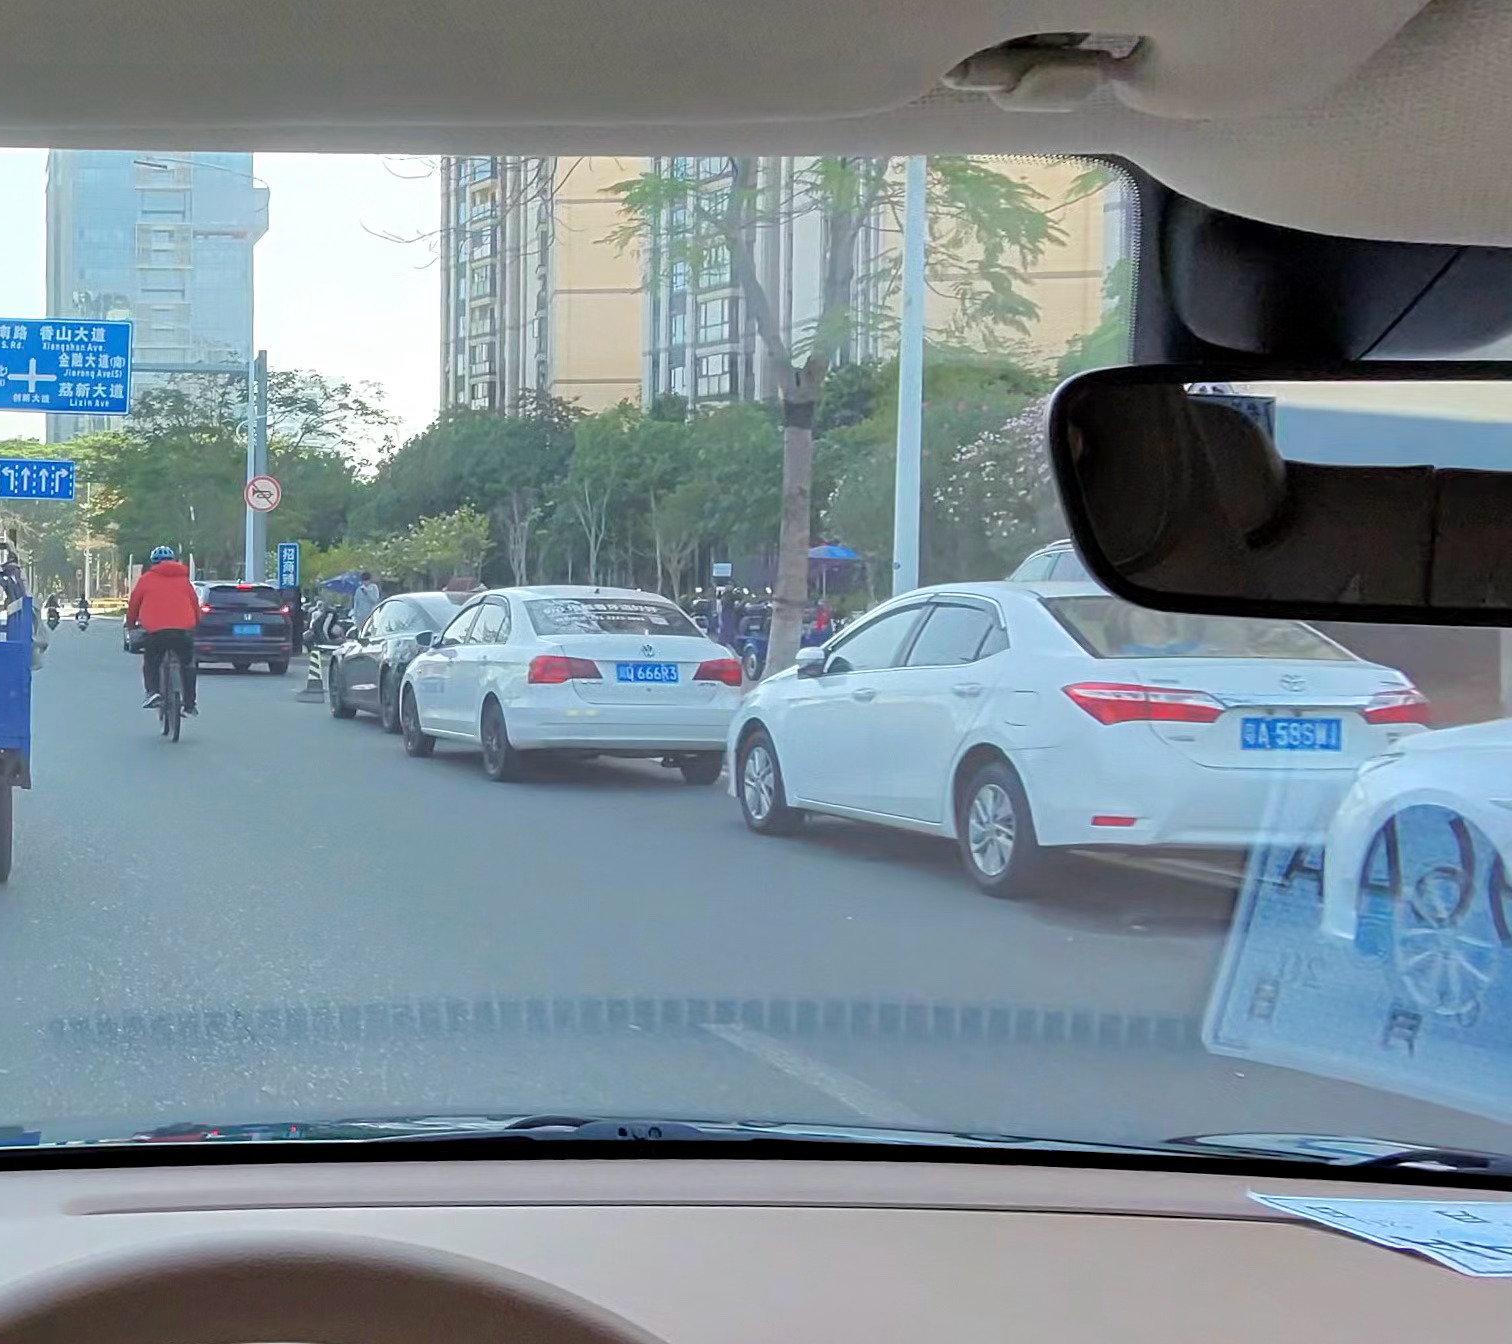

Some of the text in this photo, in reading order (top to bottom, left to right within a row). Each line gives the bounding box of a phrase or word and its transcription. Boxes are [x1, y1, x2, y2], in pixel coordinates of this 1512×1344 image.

[39, 325, 106, 343] 香山大道
[58, 382, 125, 399] 荔新大道
[69, 398, 93, 407] Lixin
